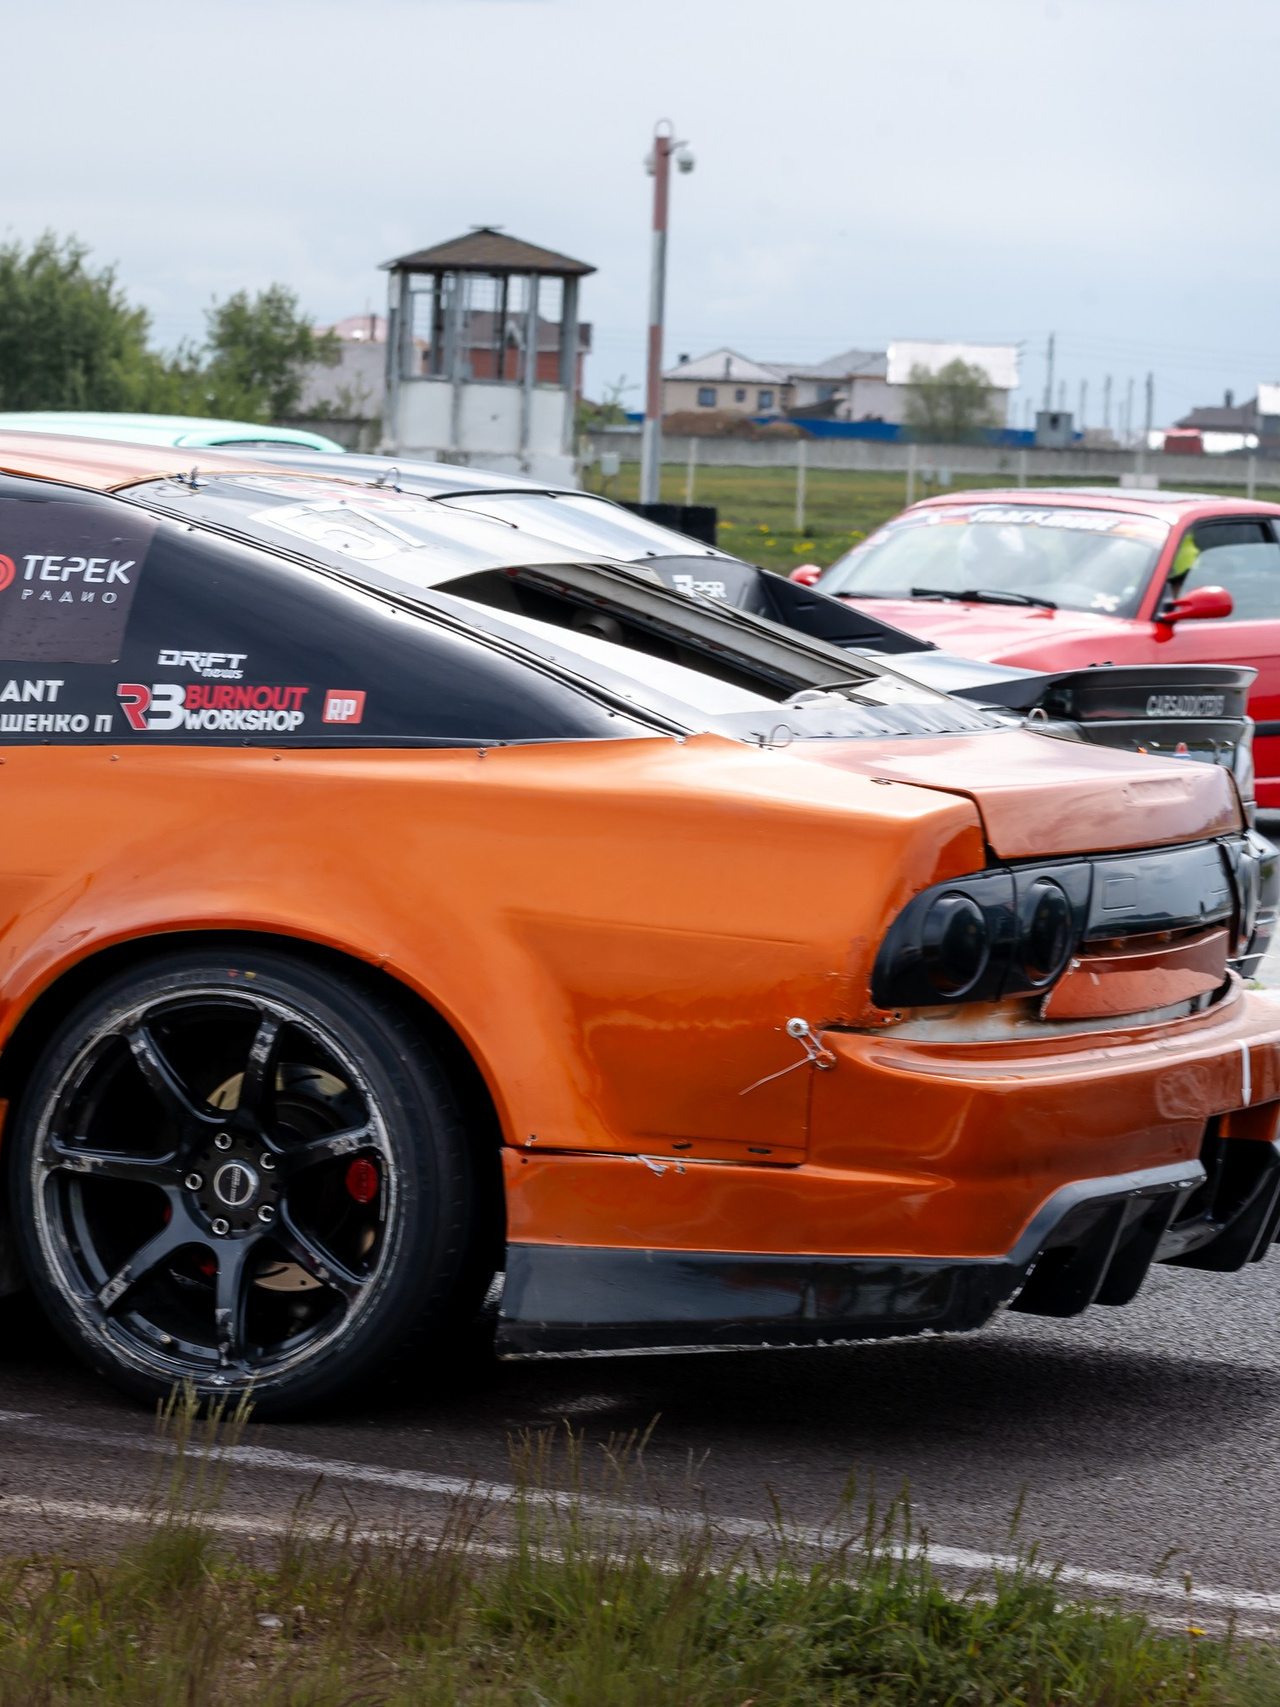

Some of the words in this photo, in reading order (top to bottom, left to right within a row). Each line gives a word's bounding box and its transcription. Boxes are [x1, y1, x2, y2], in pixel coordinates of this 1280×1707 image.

[23, 554, 136, 584] ТЕРЕК
[21, 589, 118, 604] РАДИО
[183, 685, 310, 711] BURNOUT
[183, 710, 305, 732] WORKSHOP
[325, 698, 357, 722] RP
[94, 714, 113, 732] П
